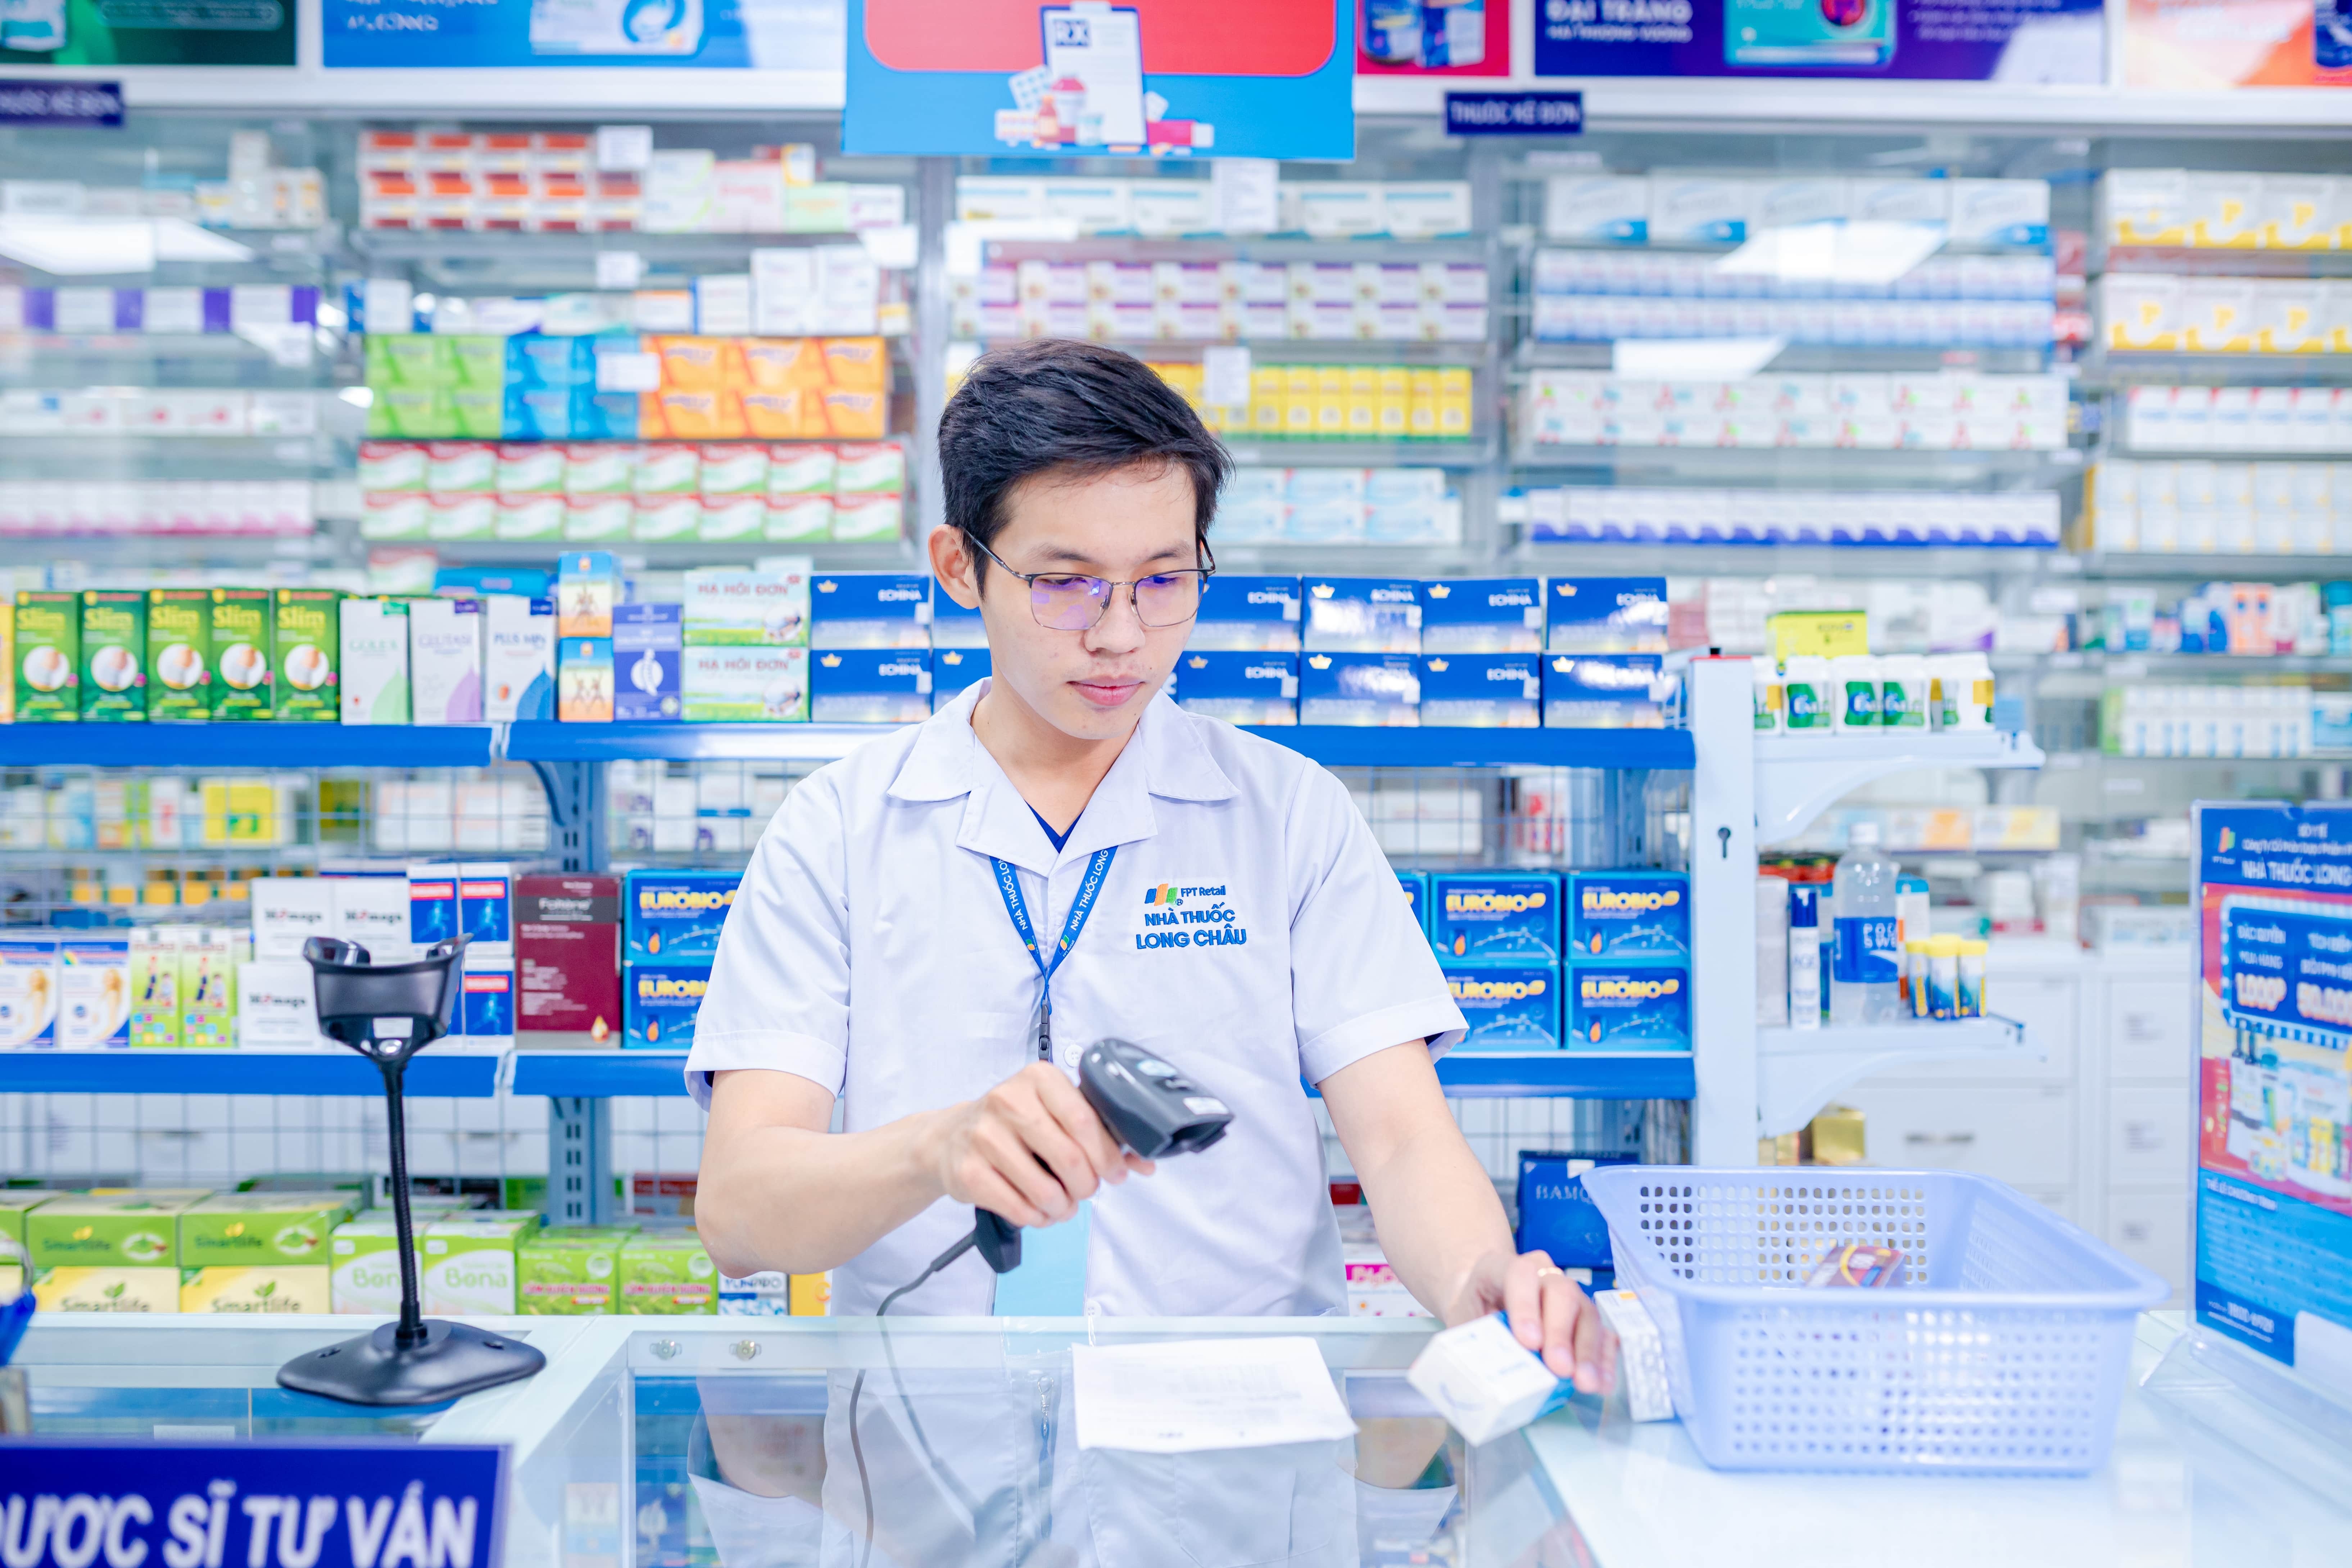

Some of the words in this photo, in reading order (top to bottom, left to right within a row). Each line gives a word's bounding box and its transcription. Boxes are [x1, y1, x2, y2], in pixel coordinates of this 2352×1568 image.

[1002, 875, 1020, 910] THUỐC
[1070, 910, 1084, 931] NHÀ
[1079, 875, 1098, 908] THUỐC
[1095, 849, 1109, 876] LONG
[1180, 887, 1198, 897] FPT
[1199, 885, 1226, 896] Retail
[1014, 908, 1028, 931] NHÀ
[1144, 907, 1179, 926] NHÀ
[1180, 901, 1236, 924] THUỐC
[1067, 939, 1075, 952] Retail
[1136, 932, 1191, 950] LONG
[1193, 923, 1247, 947] CHÂU
[241, 1493, 339, 1568] TƯ
